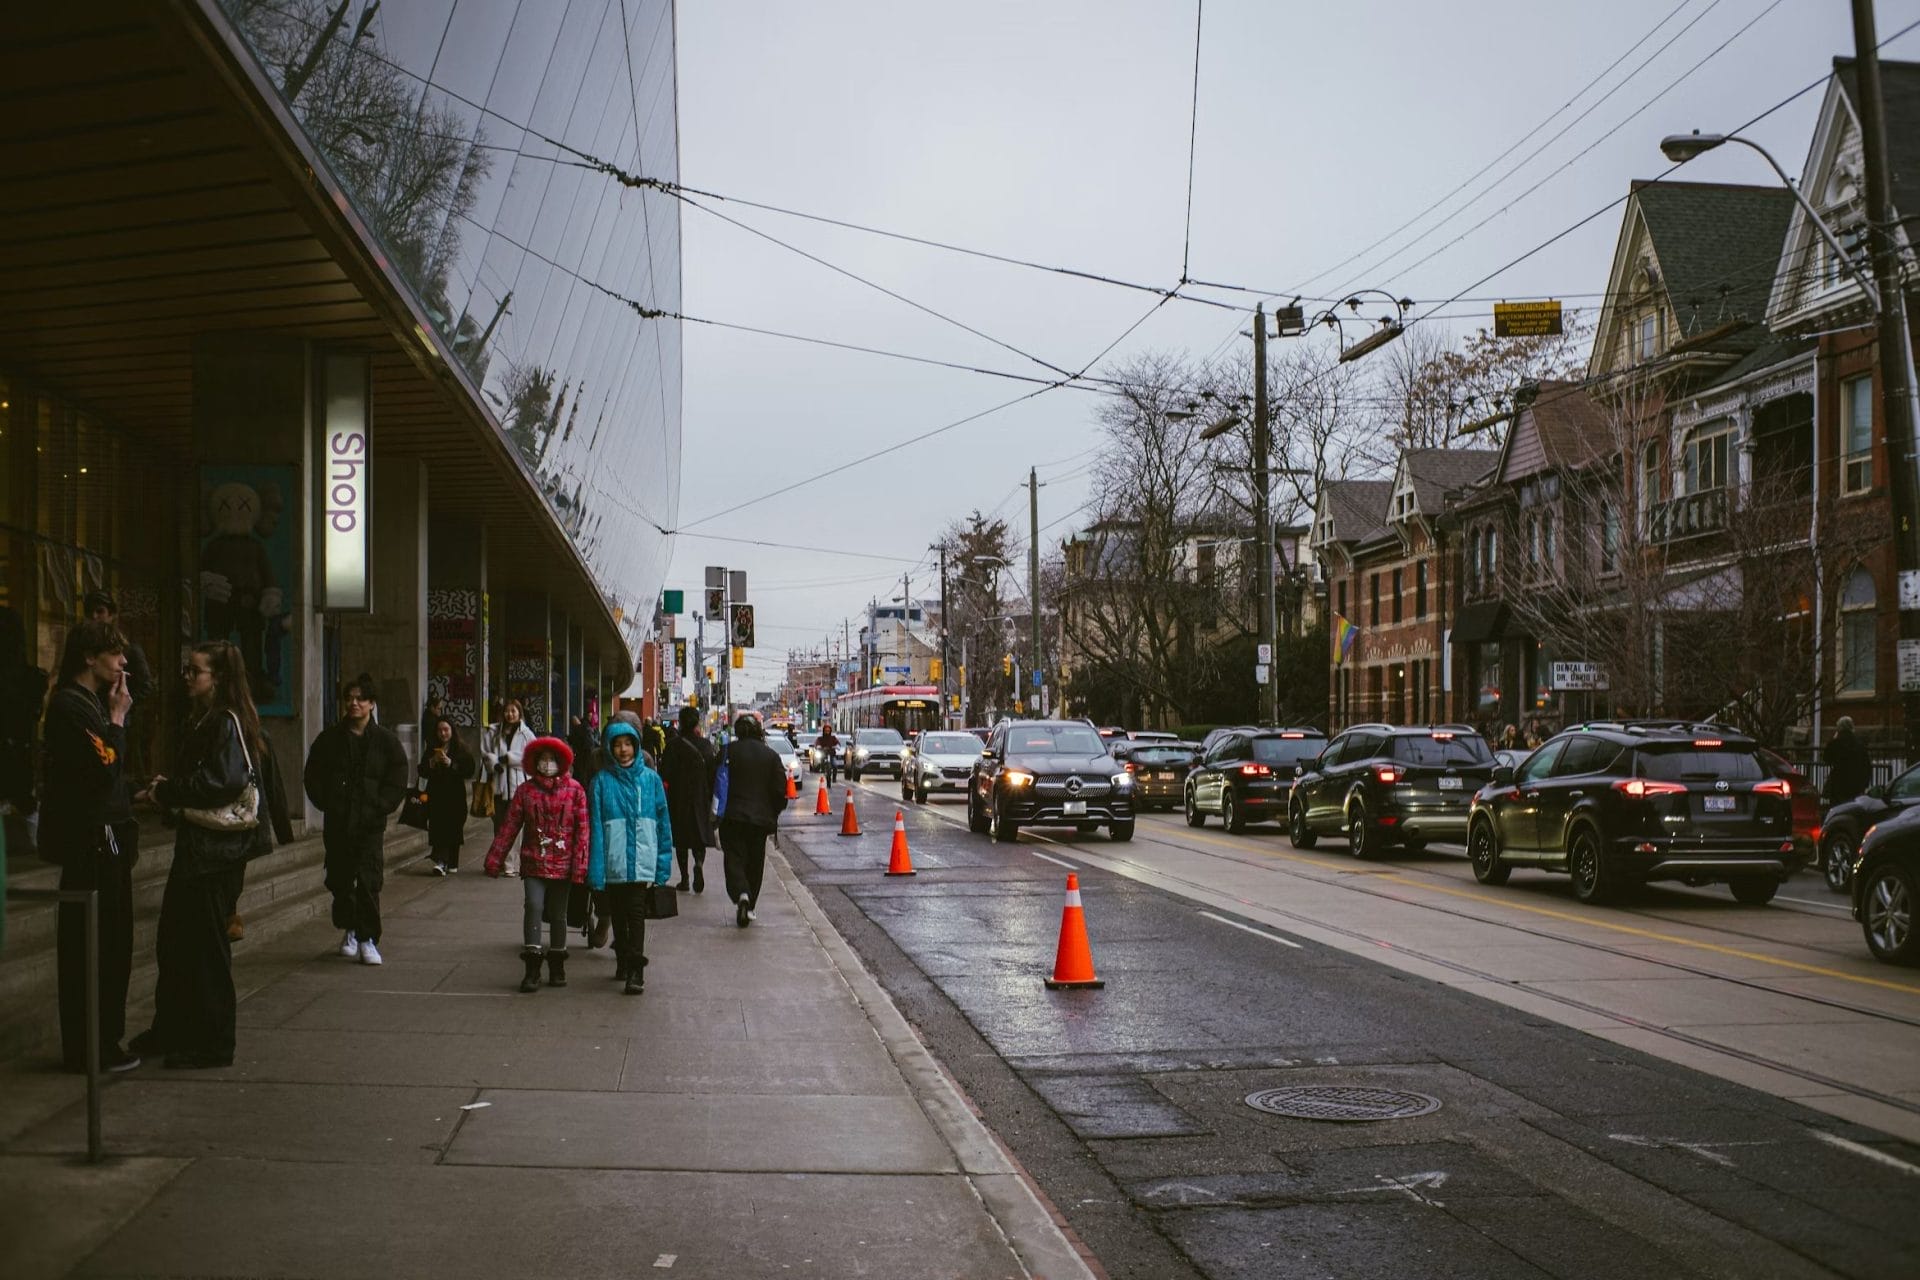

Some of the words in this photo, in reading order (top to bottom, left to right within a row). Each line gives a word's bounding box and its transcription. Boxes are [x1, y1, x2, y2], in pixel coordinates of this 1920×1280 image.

[1510, 303, 1546, 311] CAUTION
[1497, 312, 1524, 320] SECTION
[1525, 311, 1559, 320] INSULATOR
[1509, 327, 1534, 335] POWER
[1535, 326, 1548, 334] OFF
[325, 432, 365, 532] Shop
[1556, 663, 1582, 673] DENTAL
[1584, 663, 1607, 673] OFFIC
[1556, 673, 1568, 682] DR.
[1570, 673, 1591, 682] DAVID
